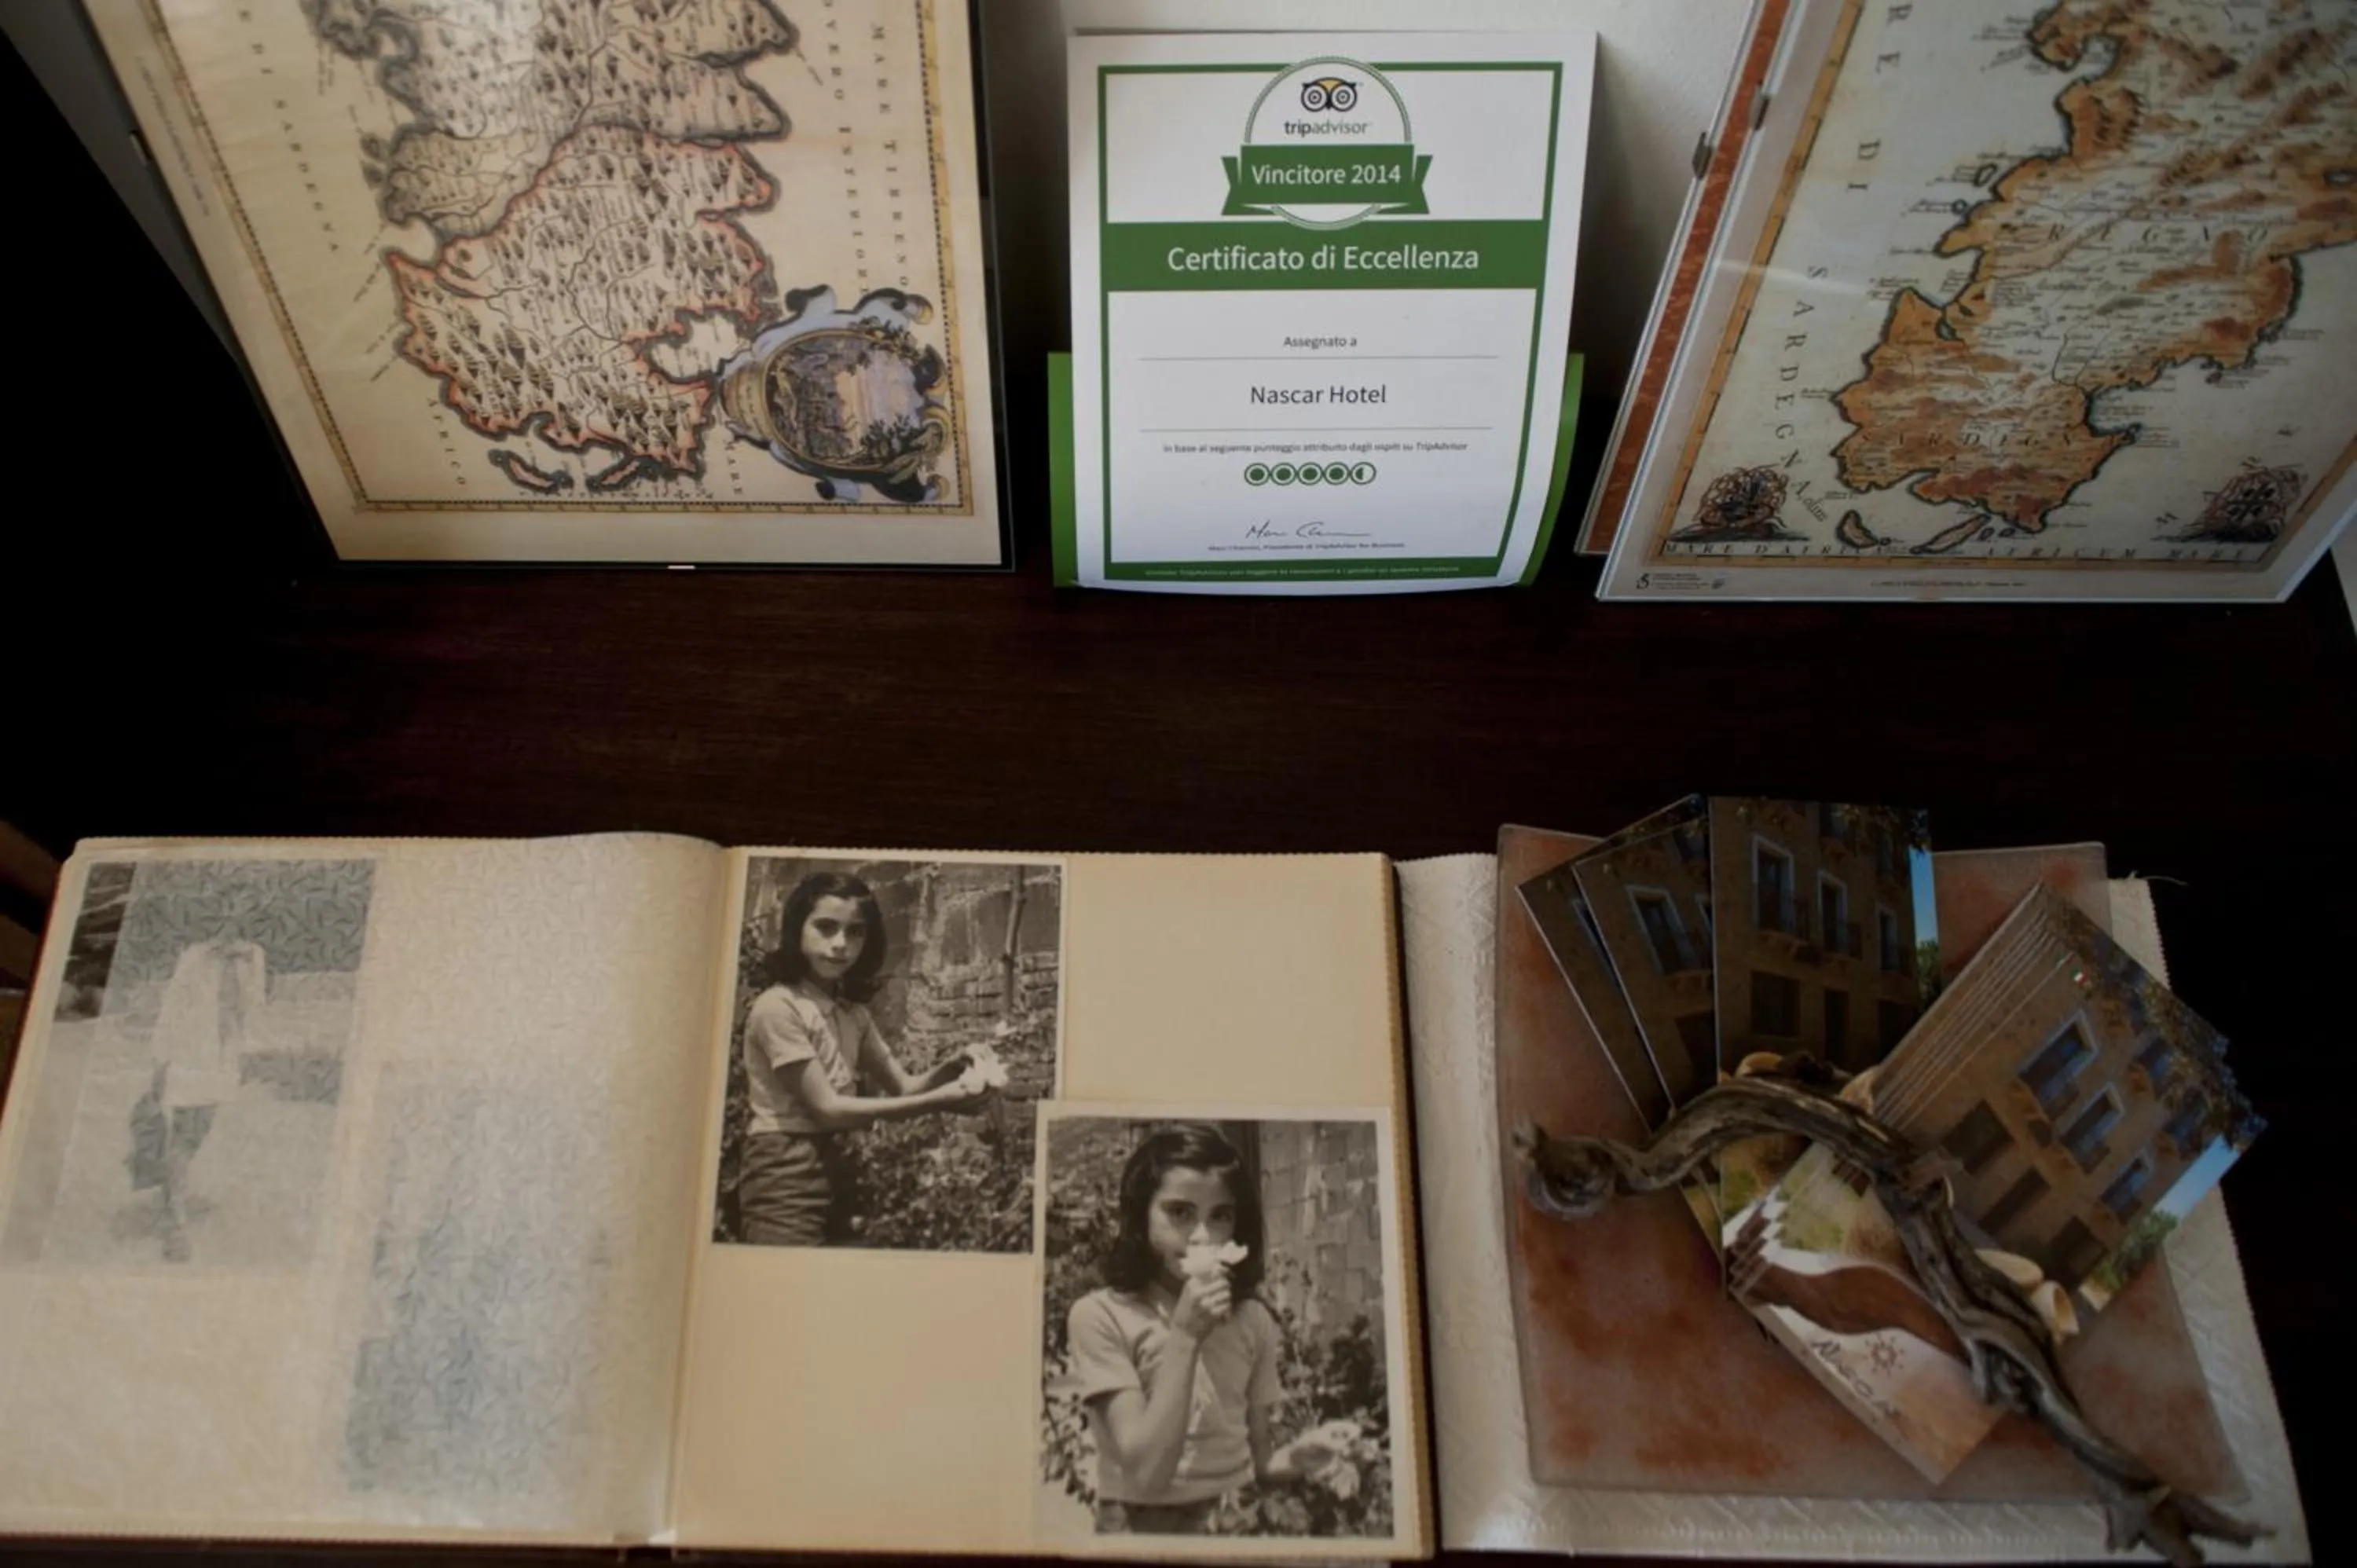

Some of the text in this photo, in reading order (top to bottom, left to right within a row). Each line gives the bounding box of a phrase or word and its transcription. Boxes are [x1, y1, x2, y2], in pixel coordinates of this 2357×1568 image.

[1284, 119, 1368, 137] tripadvisor
[1251, 163, 1402, 185] Vincitore 2014
[1167, 244, 1479, 271] Certificato di Eccellenza
[1283, 335, 1358, 350] Assegnato a
[1250, 383, 1387, 405] Nascar Hotel
[1417, 441, 1468, 452] TripAdvisor
